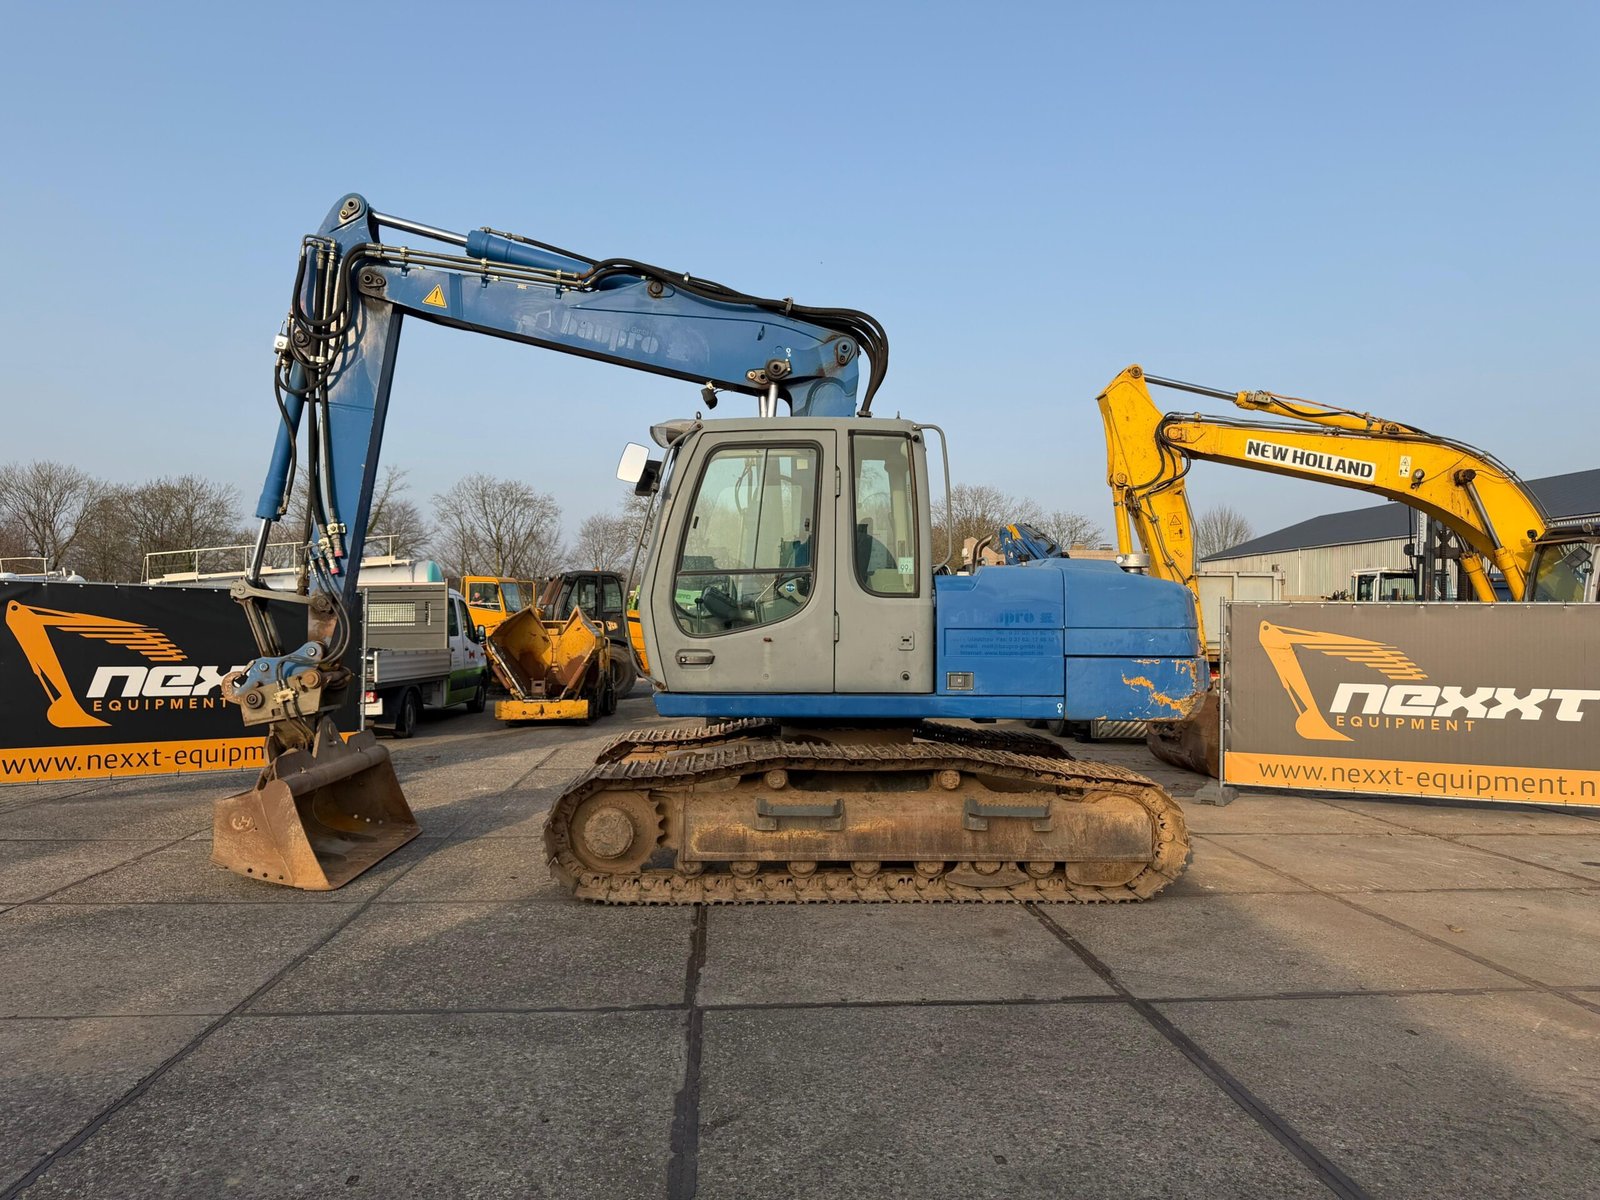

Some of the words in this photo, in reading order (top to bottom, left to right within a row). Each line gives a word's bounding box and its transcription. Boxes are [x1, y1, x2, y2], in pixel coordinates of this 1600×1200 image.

[1247, 441, 1289, 462] NEW
[1292, 450, 1373, 478] HOLLAND
[93, 697, 229, 712] EQUIPMENT
[1330, 683, 1600, 722] nexxt
[1336, 715, 1475, 732] EQUIPMENT
